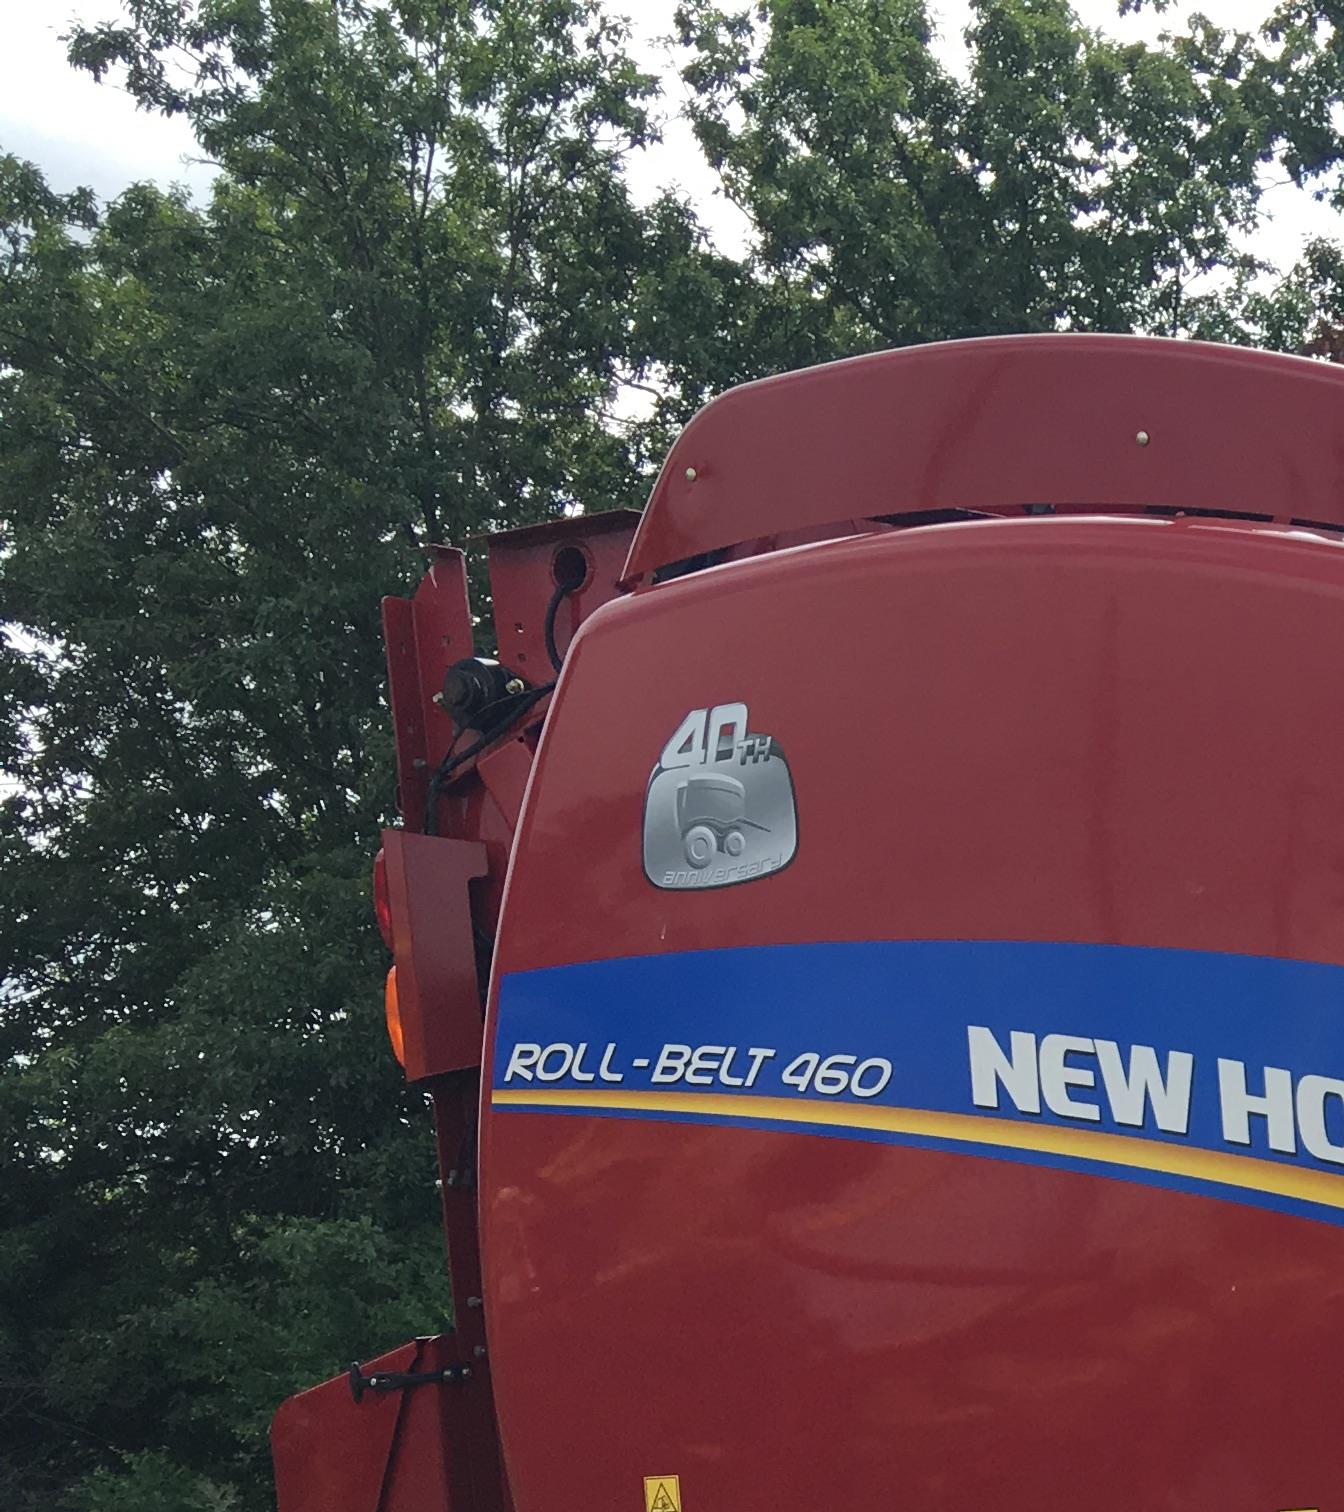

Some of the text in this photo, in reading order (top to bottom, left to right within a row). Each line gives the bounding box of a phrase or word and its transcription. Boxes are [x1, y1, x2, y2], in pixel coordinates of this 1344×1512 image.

[663, 853, 783, 885] anniversary
[781, 1052, 893, 1099] 460
[967, 1024, 1194, 1135] NEW
